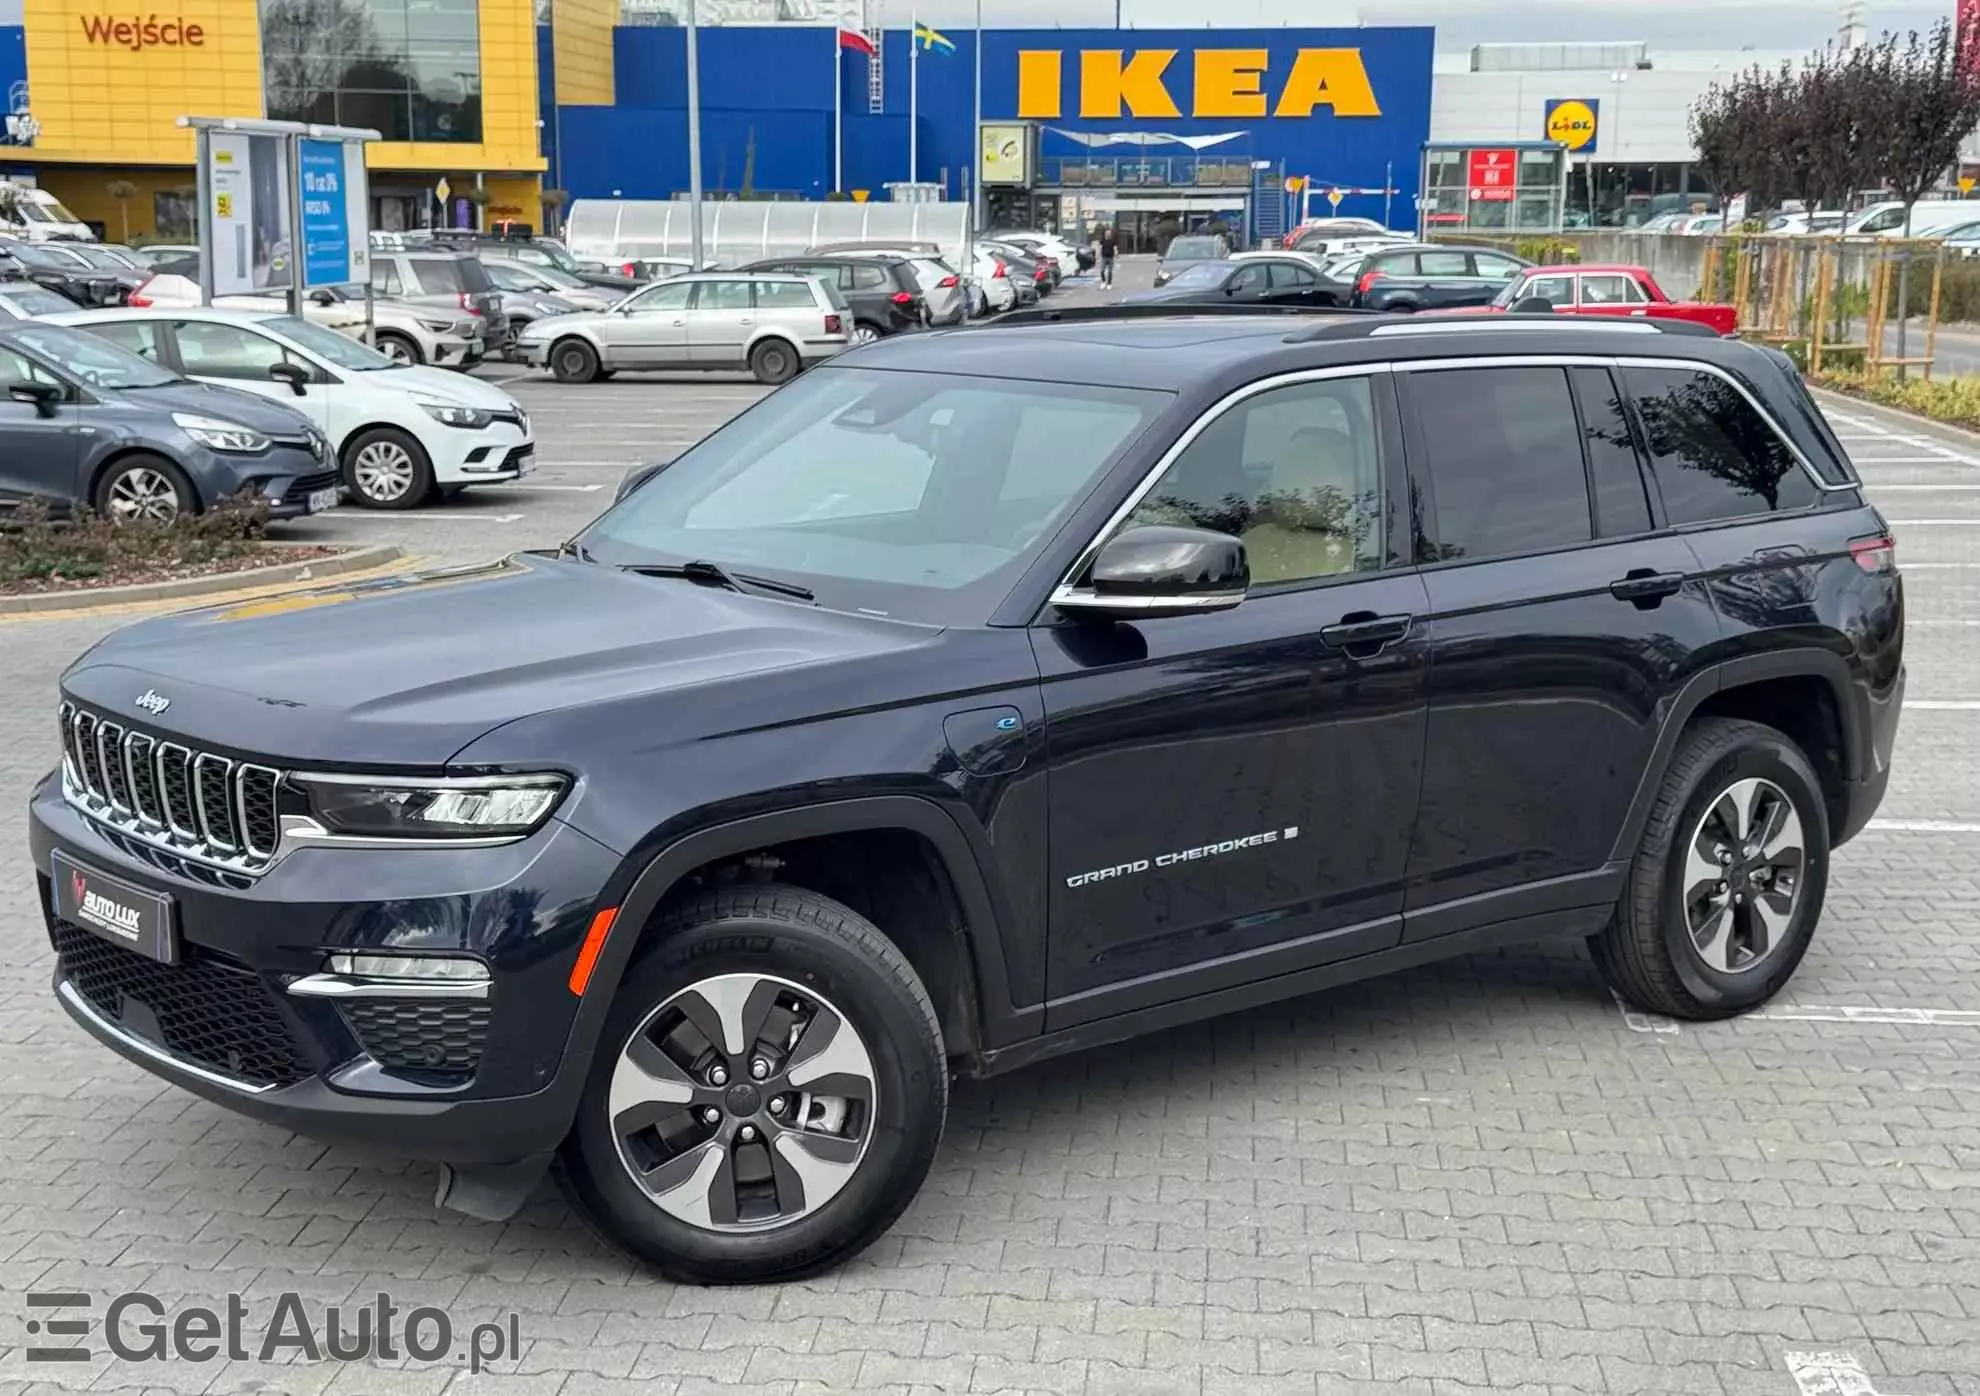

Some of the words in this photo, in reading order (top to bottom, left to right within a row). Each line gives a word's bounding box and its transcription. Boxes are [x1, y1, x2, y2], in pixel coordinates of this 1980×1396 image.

[80, 13, 204, 51] Wejście
[1017, 48, 1382, 117] IKEA
[135, 689, 170, 714] Jeep
[1066, 859, 1149, 888] GRAND
[1155, 831, 1278, 868] CHEROKEE
[115, 903, 141, 929] LUX
